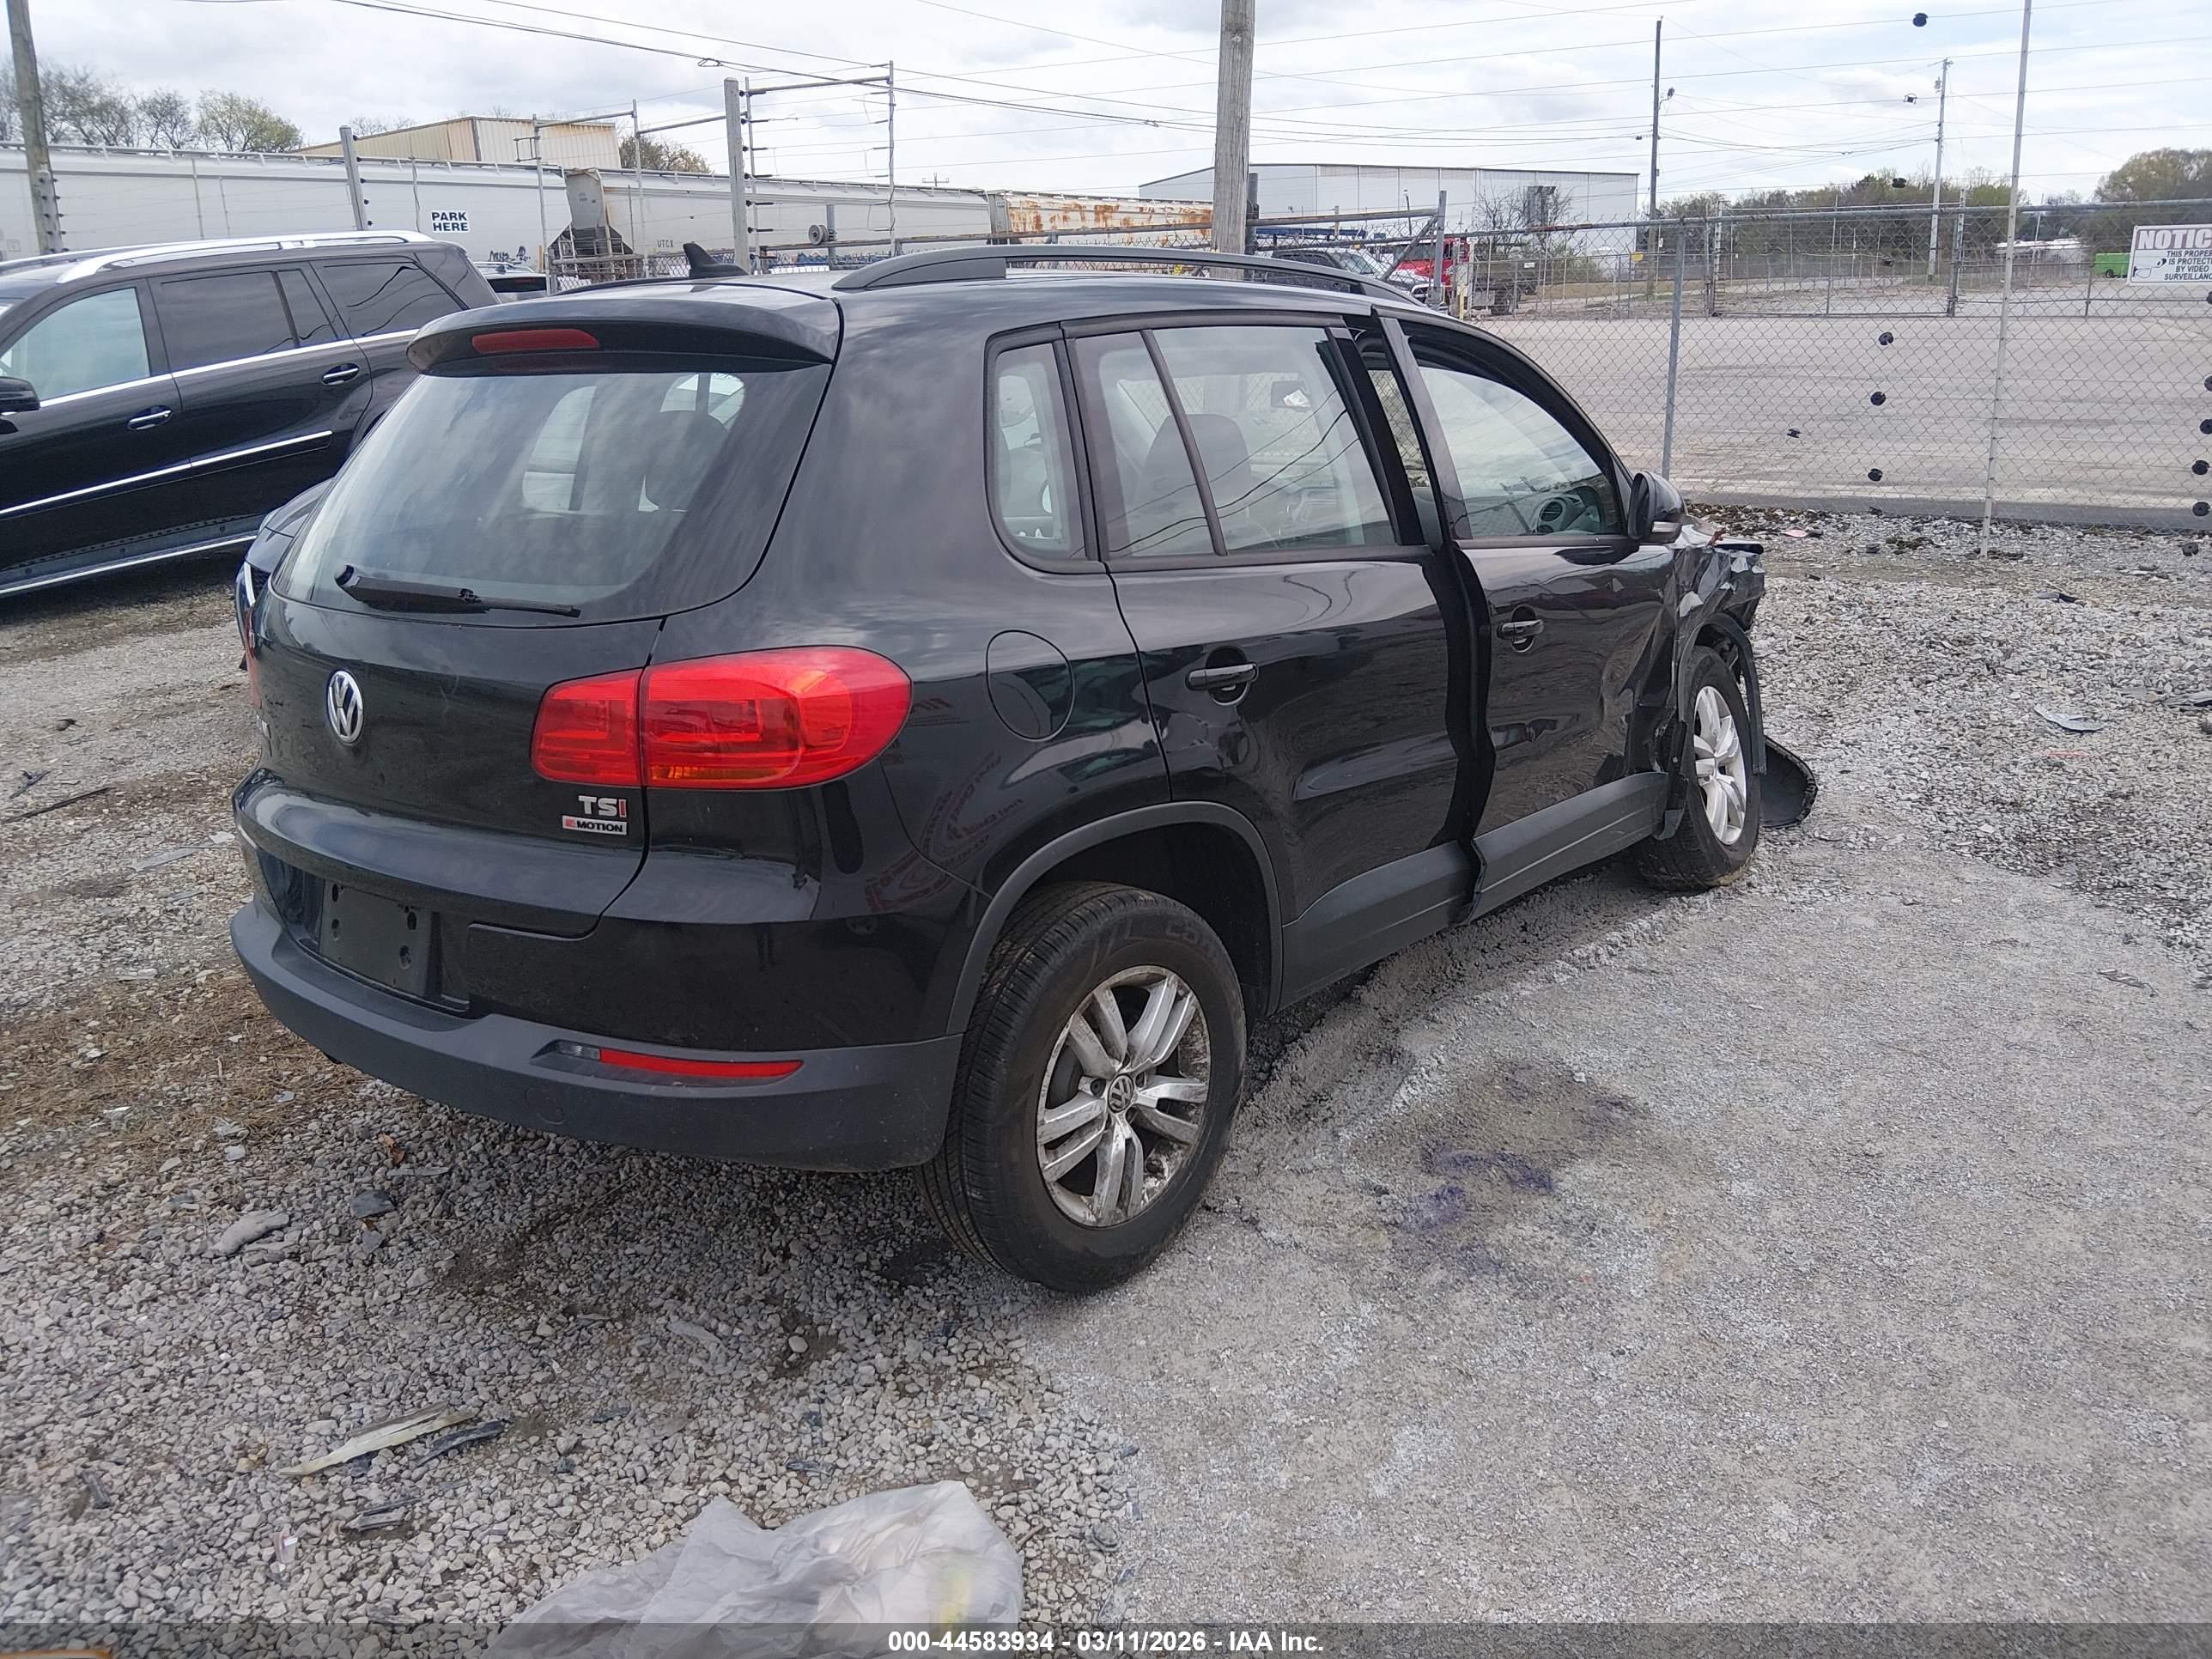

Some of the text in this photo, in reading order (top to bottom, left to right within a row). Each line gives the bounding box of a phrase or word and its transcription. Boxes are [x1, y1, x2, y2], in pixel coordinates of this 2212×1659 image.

[431, 211, 468, 222] PARK
[432, 222, 469, 232] HERE
[657, 239, 674, 248] UTCX
[2177, 257, 2212, 265] PROTECT
[2187, 264, 2209, 273] VIDEO
[578, 794, 628, 818] TSI
